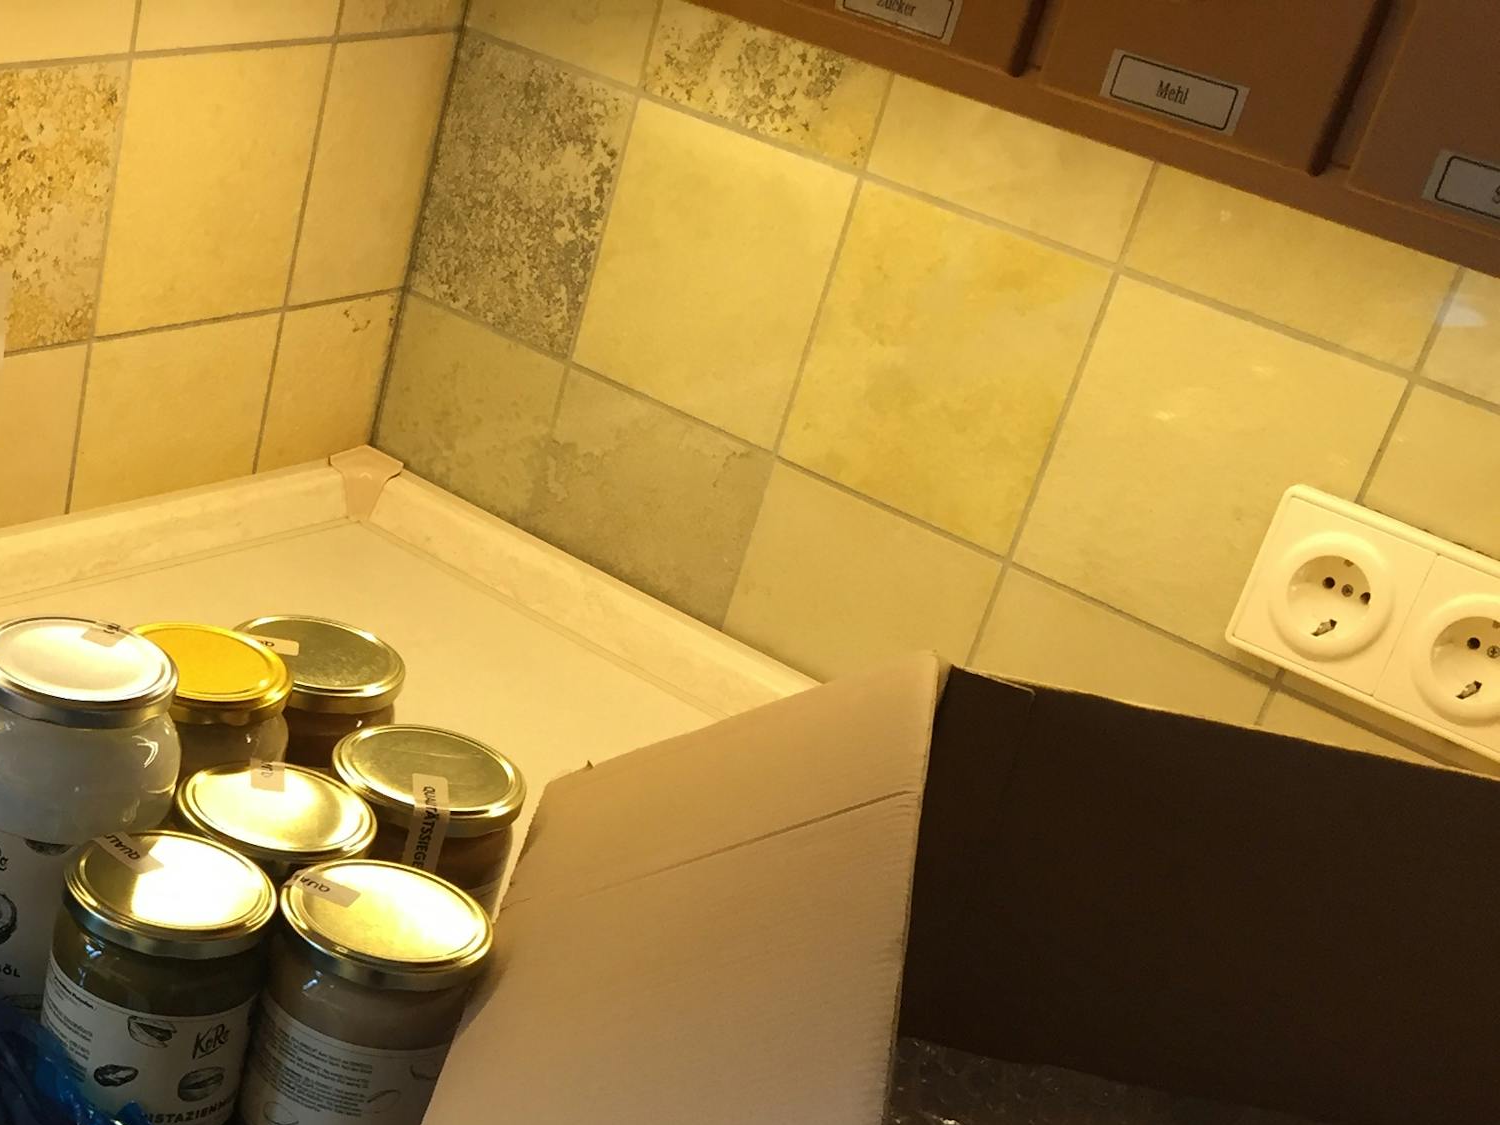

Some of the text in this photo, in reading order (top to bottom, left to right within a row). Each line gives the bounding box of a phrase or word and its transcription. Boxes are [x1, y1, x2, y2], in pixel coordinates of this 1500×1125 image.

[1155, 80, 1190, 105] Mehl
[192, 1023, 230, 1060] KoRo
[141, 1099, 238, 1124] ISTAZIENM
